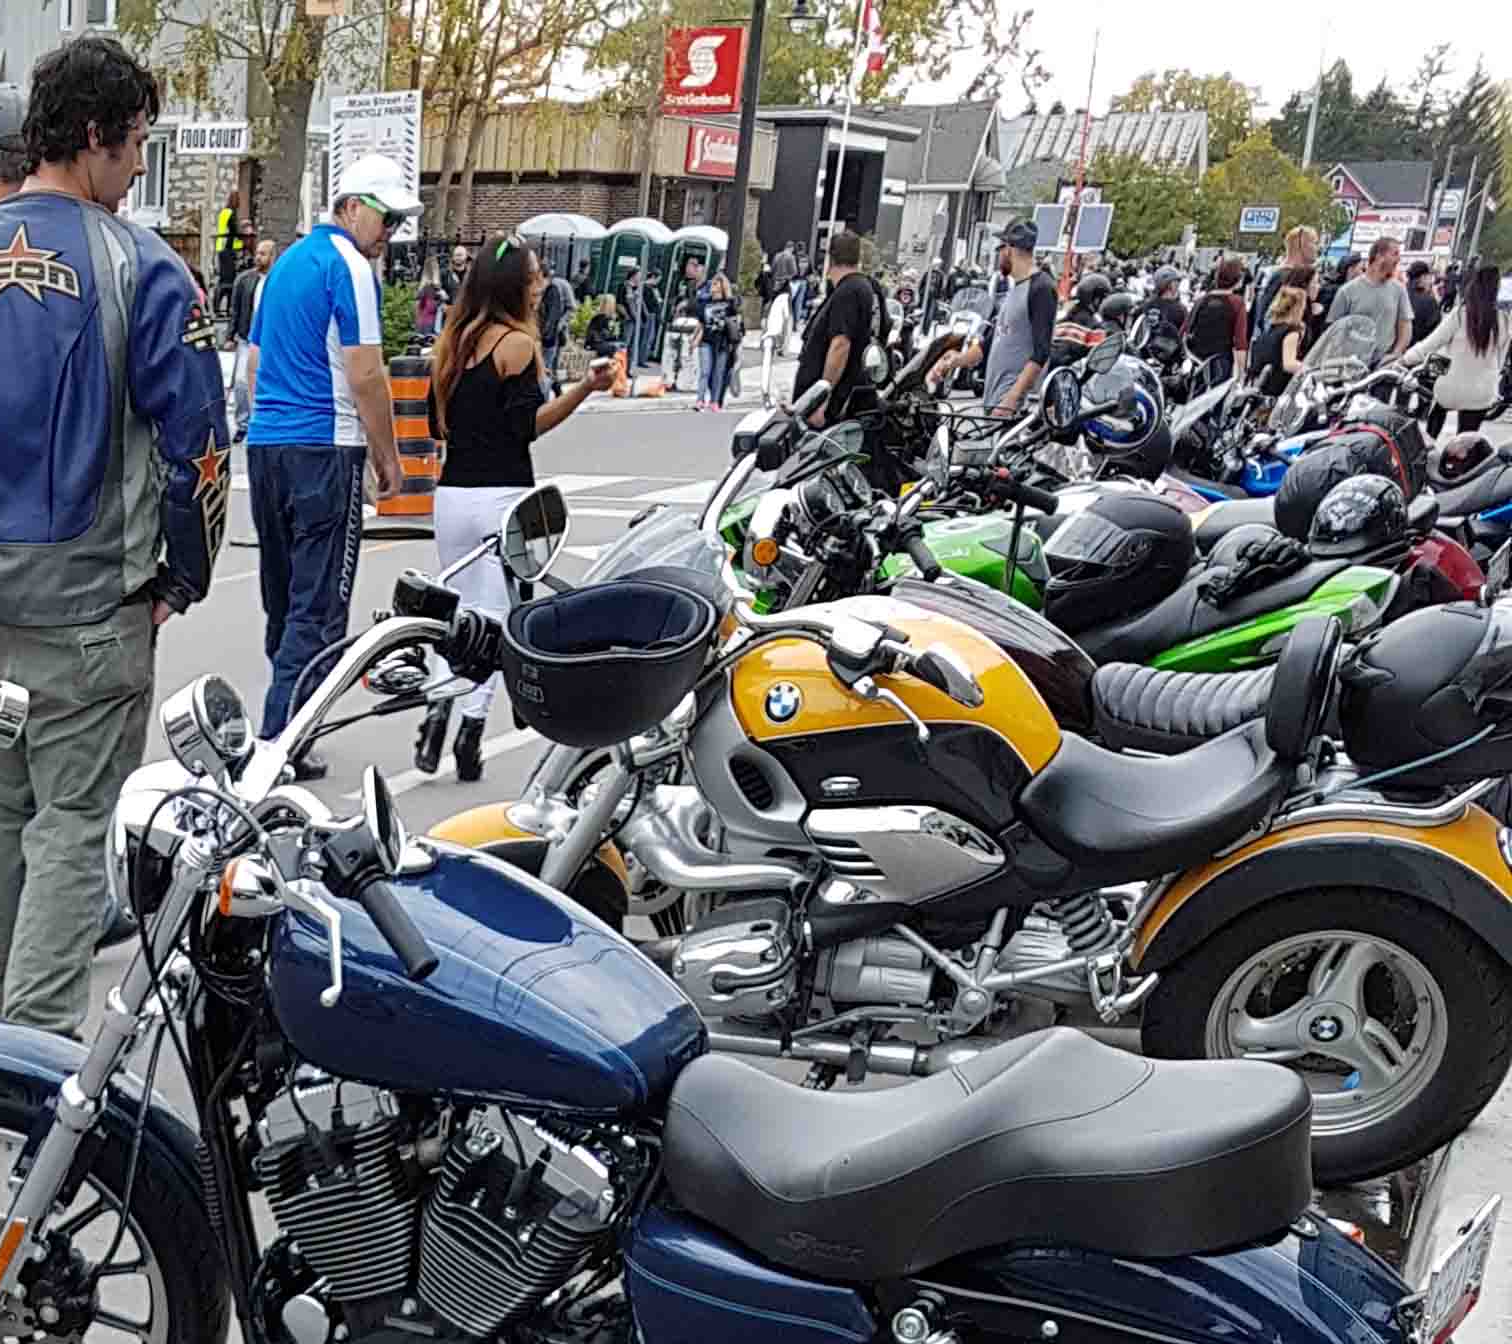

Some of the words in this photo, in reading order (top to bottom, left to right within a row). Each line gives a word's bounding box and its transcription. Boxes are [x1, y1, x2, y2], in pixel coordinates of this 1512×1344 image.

[347, 99, 371, 107] Main
[373, 96, 402, 106] Street
[333, 108, 383, 120] MOTORCYCLE
[384, 105, 416, 116] PARKING
[180, 128, 206, 149] FOOD
[209, 128, 242, 148] COURT
